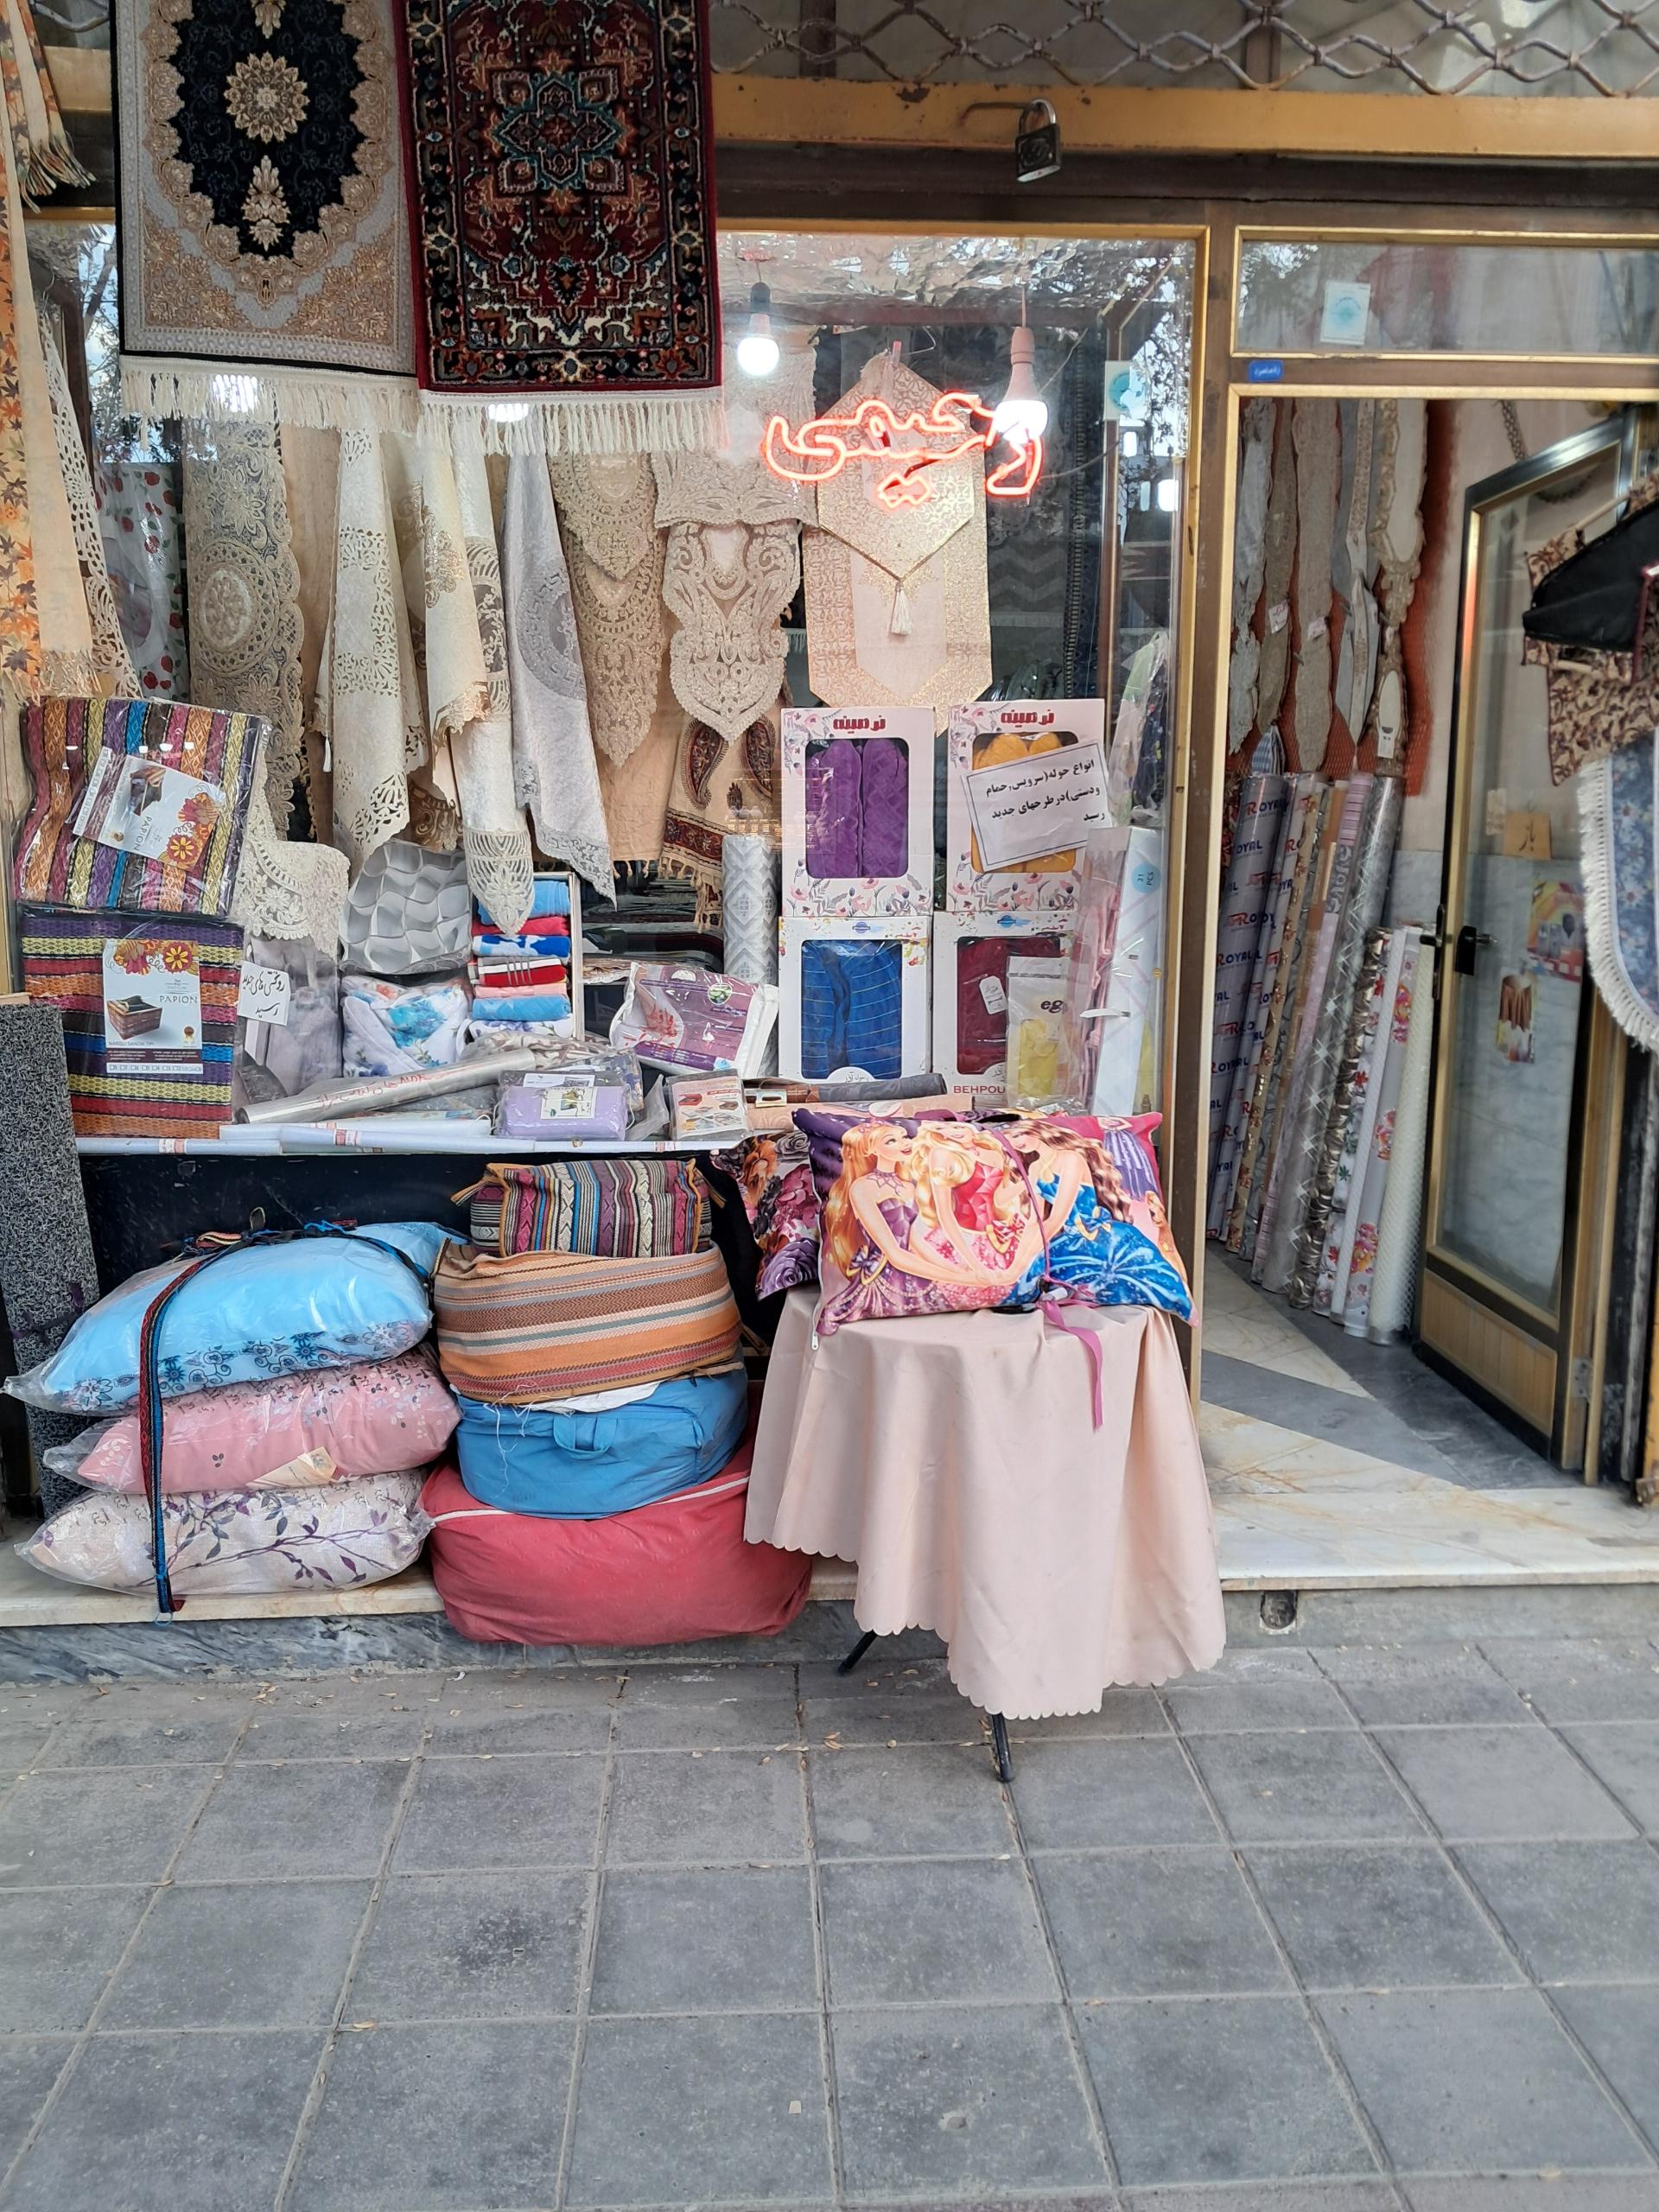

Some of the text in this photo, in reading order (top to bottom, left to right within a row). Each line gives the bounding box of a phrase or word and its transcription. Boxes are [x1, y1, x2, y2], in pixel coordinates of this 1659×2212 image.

[1072, 759, 1095, 775] انواع
[991, 806, 1015, 819] جدید
[1083, 811, 1105, 823] رسید
[1236, 839, 1263, 855] OYAL
[159, 995, 198, 1004] PAPION
